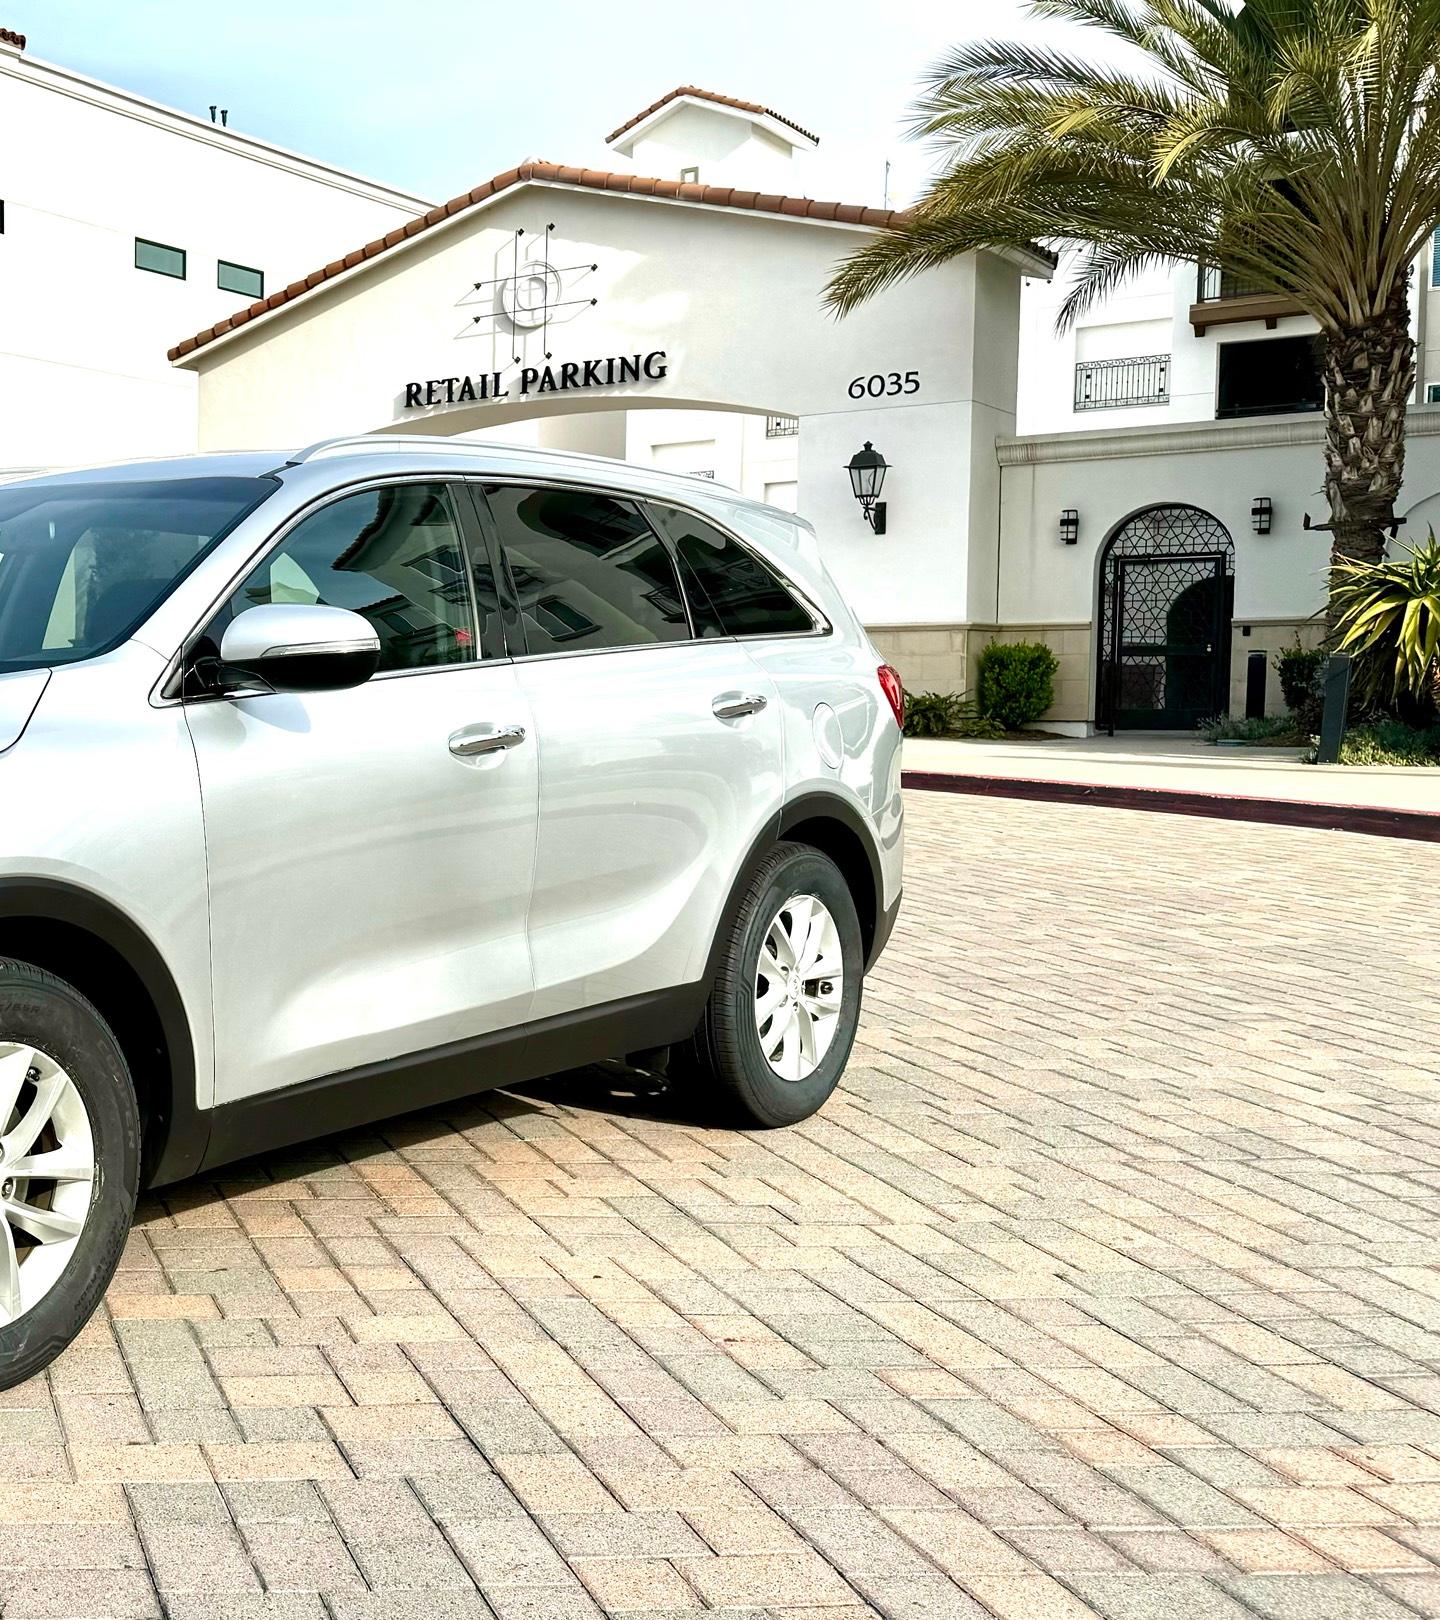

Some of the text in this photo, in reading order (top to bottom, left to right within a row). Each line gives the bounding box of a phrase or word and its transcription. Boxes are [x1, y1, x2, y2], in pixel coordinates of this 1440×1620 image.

[404, 351, 668, 408] RETAIL PARKING
[848, 371, 920, 399] 6035
